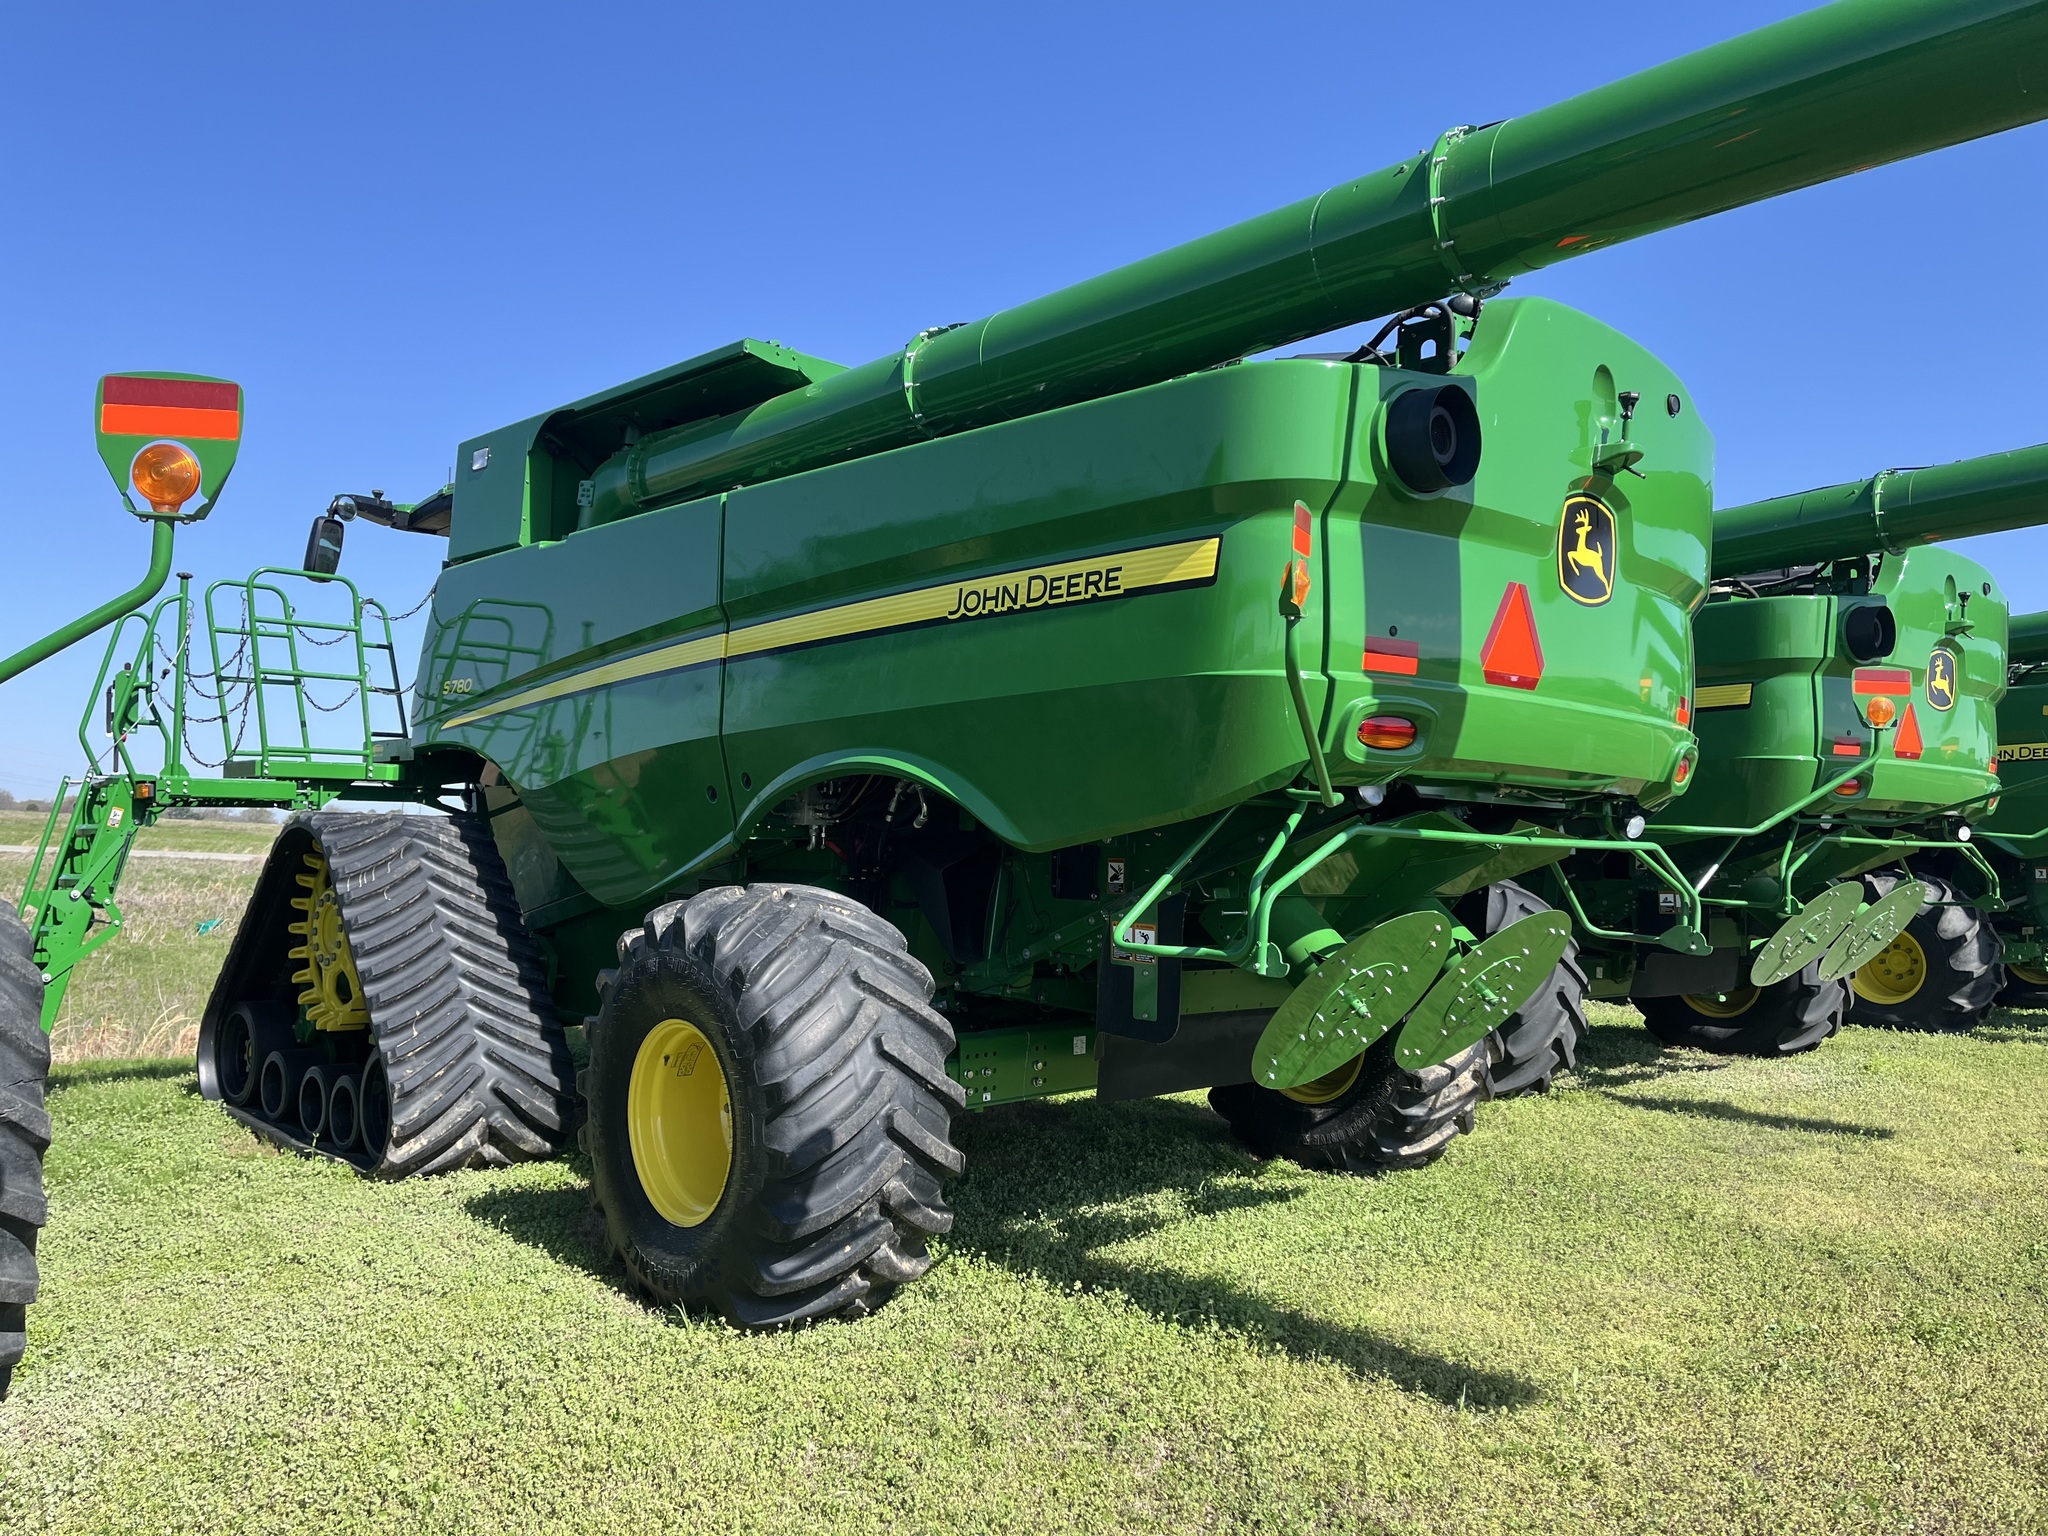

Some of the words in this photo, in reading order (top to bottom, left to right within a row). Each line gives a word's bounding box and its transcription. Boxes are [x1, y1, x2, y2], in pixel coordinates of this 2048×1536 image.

[947, 583, 1020, 617] JOHN
[1025, 566, 1123, 604] DEERE
[443, 678, 472, 695] S780
